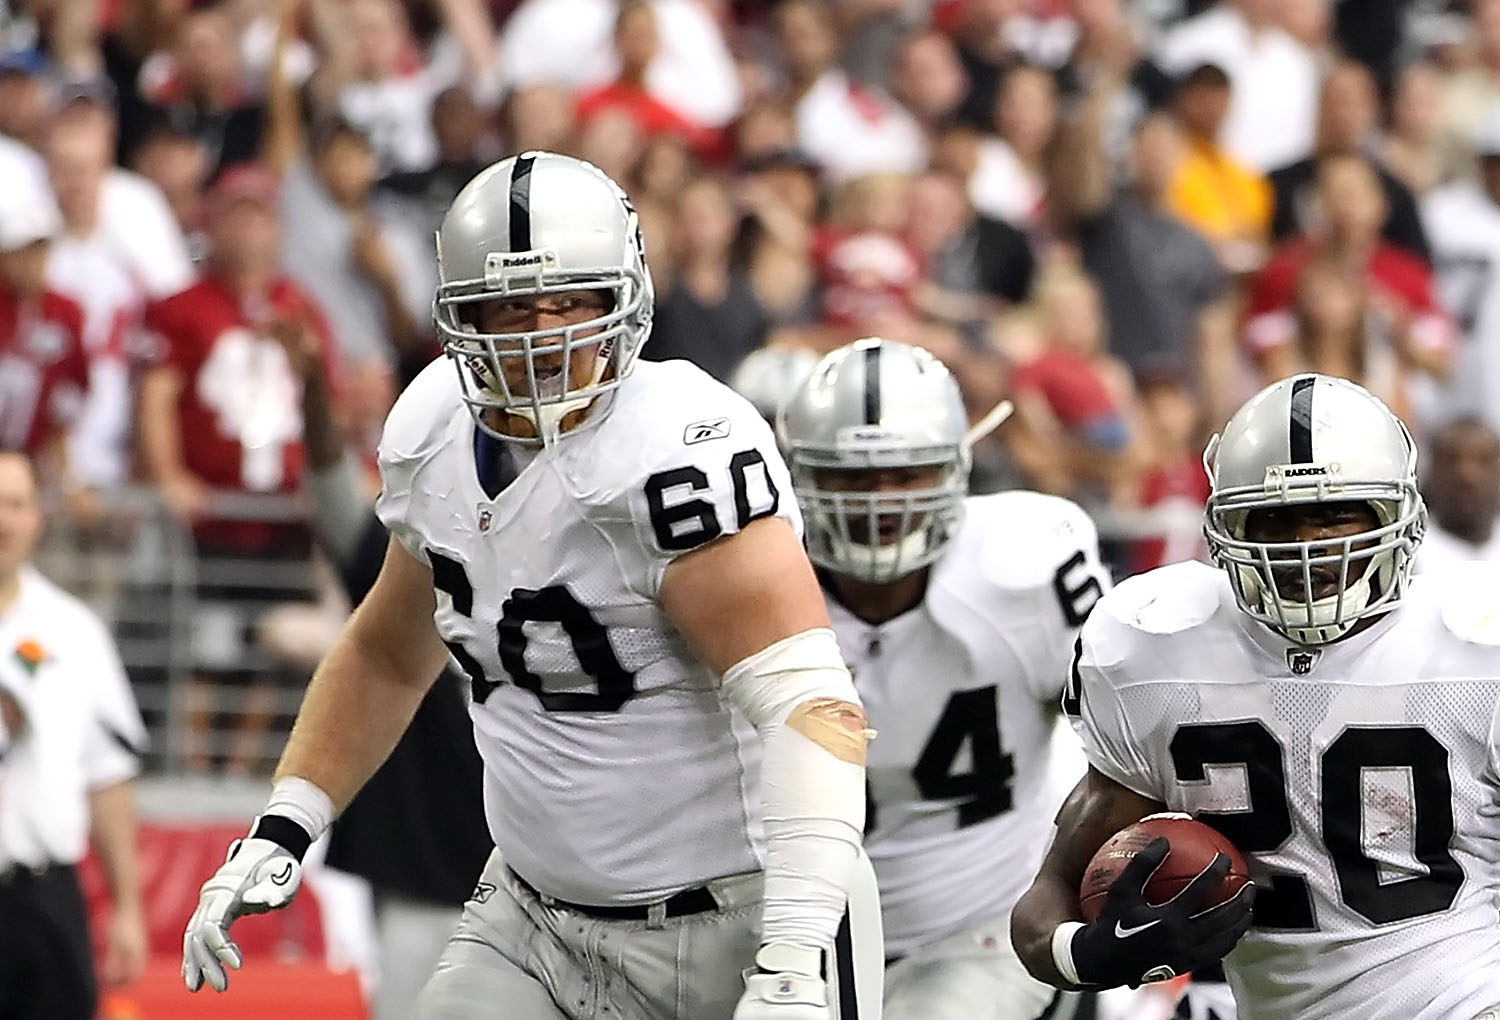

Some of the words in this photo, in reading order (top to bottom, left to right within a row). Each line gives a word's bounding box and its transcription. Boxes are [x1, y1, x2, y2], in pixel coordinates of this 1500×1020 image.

[502, 255, 541, 268] Riddell
[644, 448, 780, 551] 60
[1284, 467, 1327, 477] RAIDERS
[1168, 717, 1467, 930] 20
